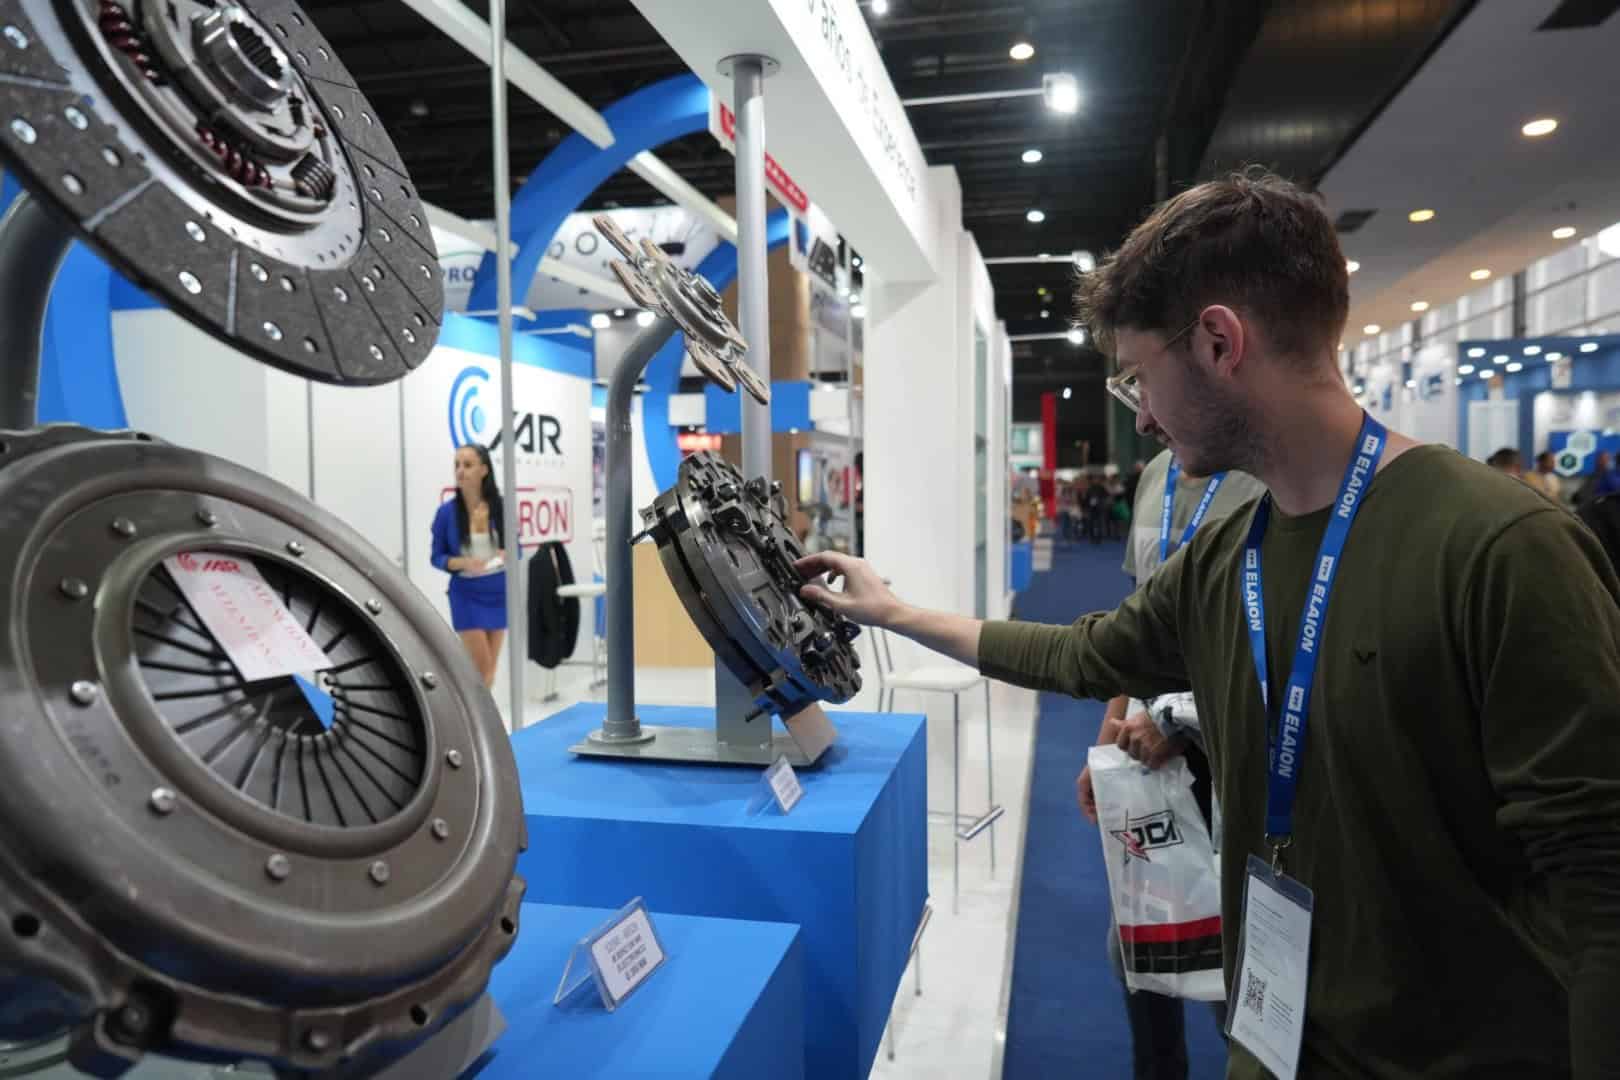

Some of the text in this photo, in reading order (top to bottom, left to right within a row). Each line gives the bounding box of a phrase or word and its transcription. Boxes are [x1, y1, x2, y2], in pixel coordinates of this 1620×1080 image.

[1337, 456, 1371, 519] ELAION
[1245, 570, 1263, 632] ELAION
[1300, 583, 1327, 653] ELAION
[1278, 714, 1302, 779] ELAION
